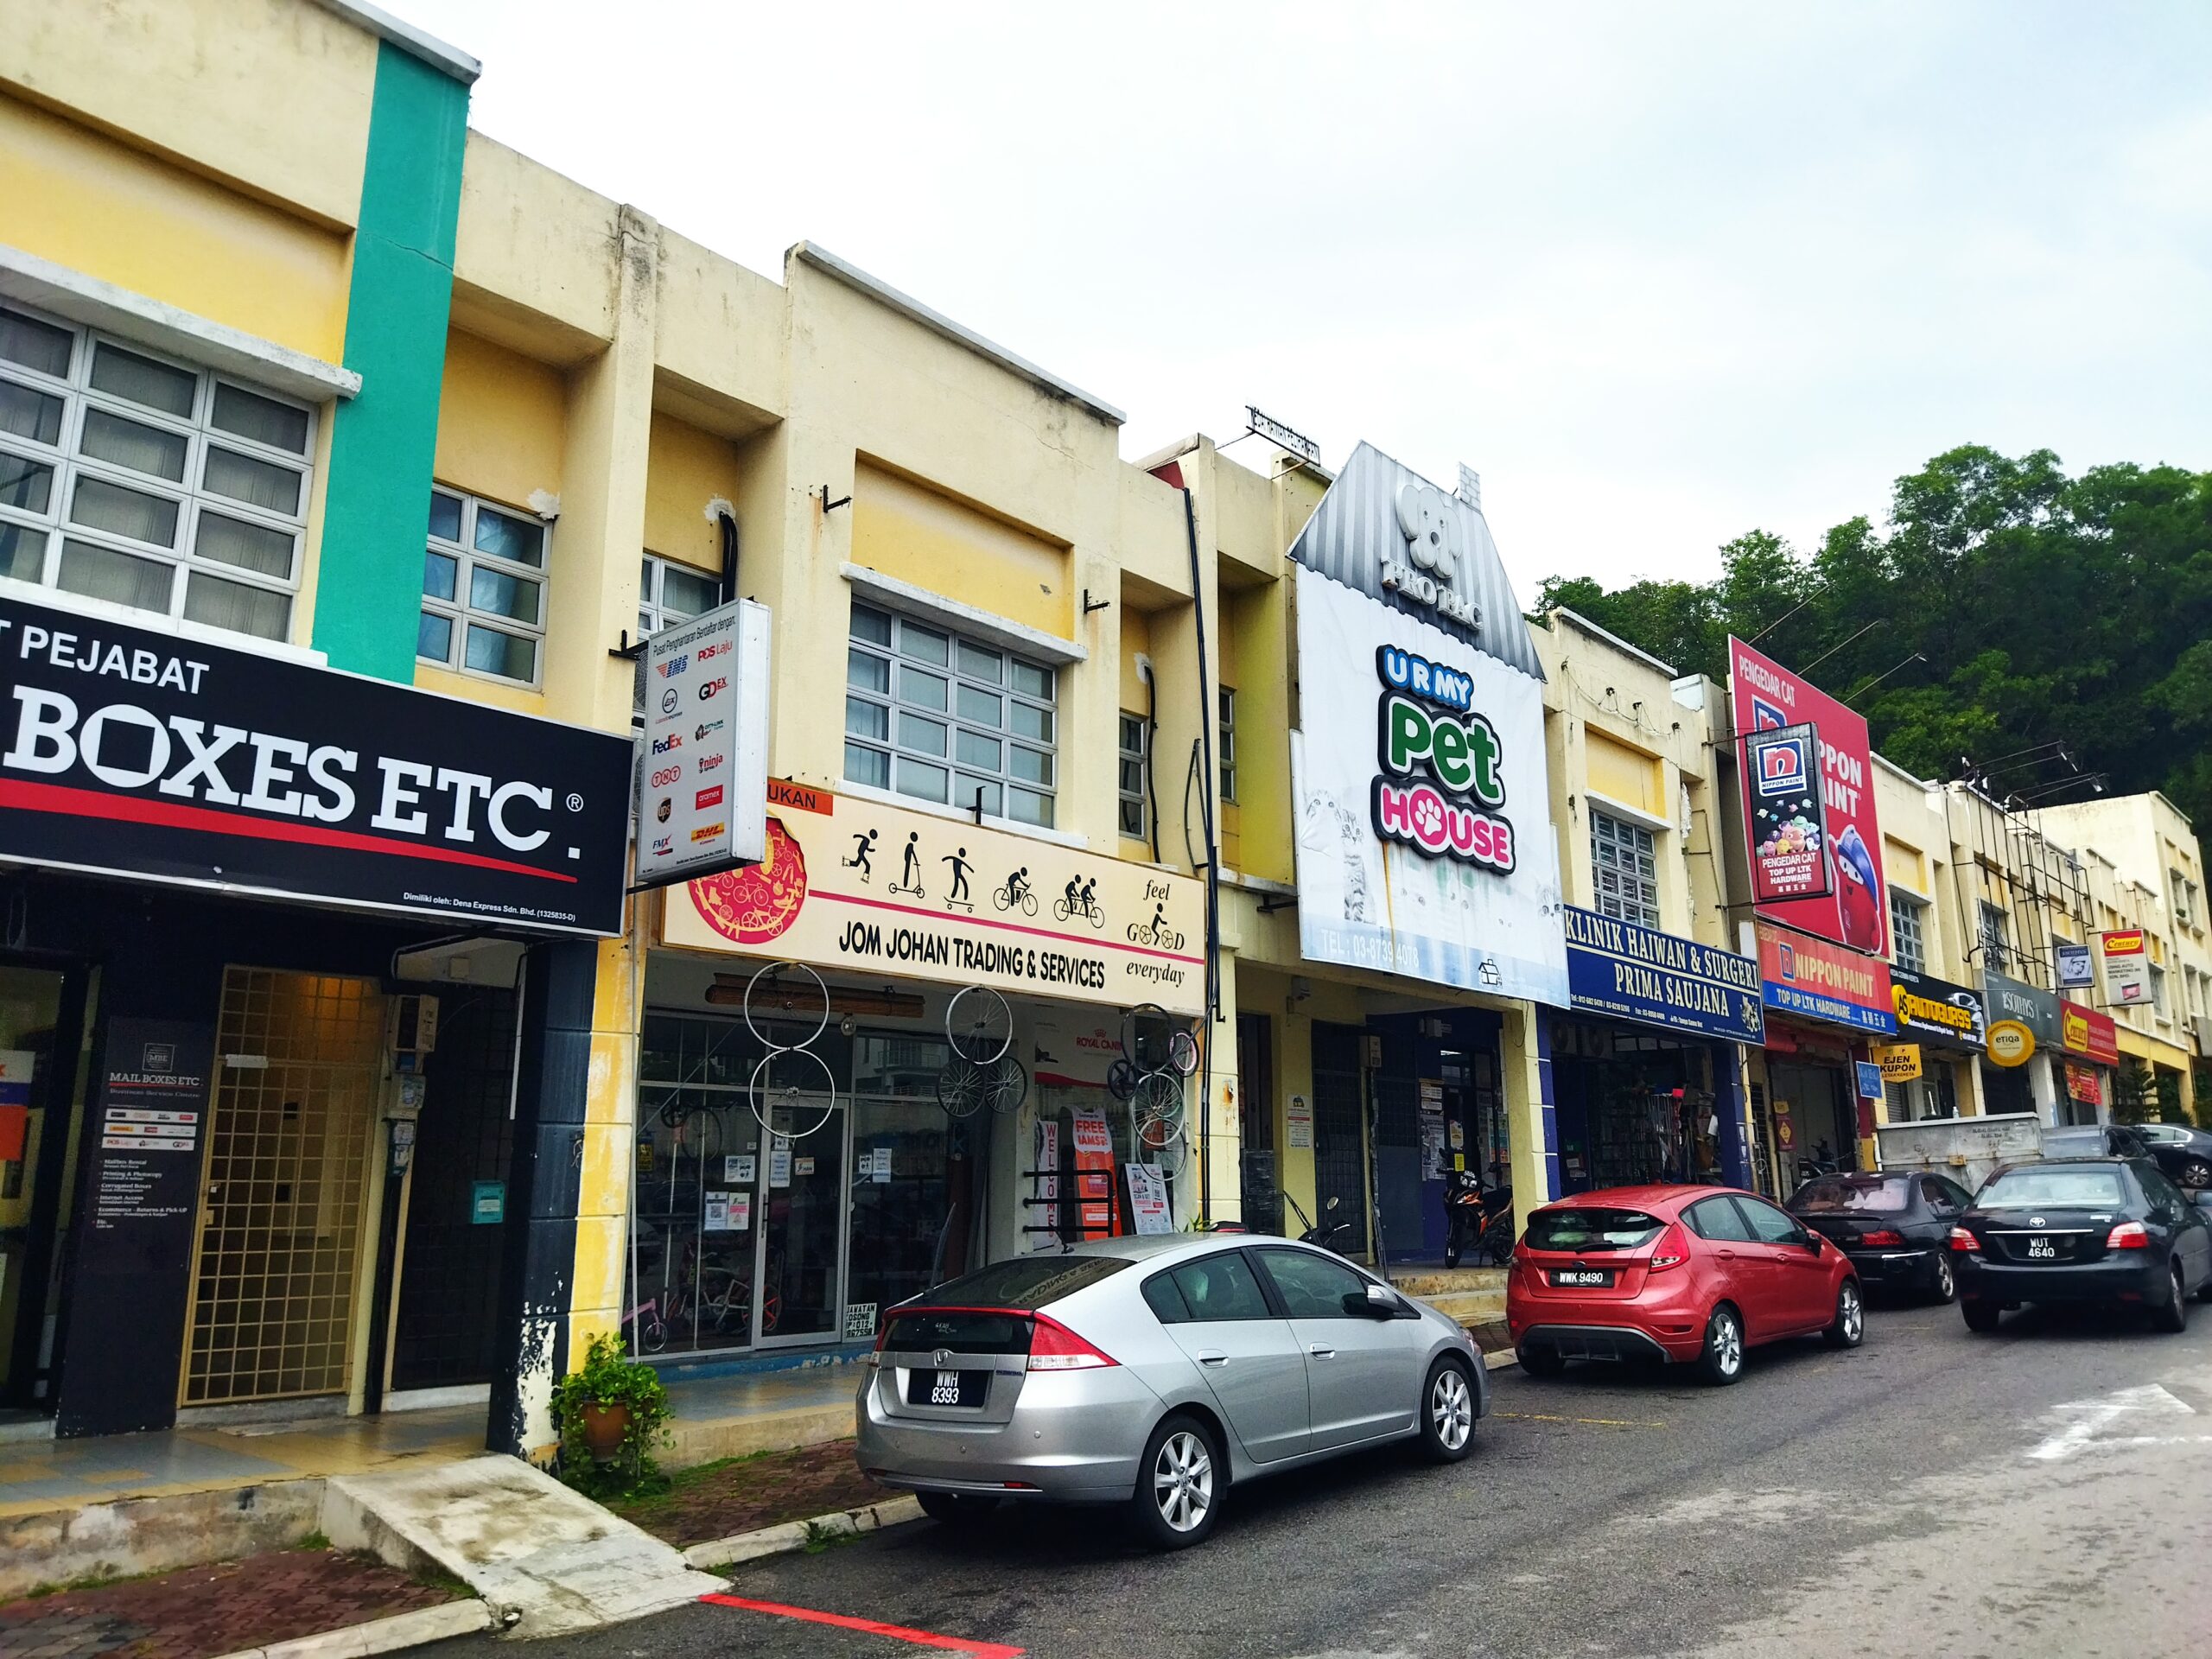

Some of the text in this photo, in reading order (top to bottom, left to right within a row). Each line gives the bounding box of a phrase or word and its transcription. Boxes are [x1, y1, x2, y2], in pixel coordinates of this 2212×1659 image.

[1380, 557, 1484, 630] PRO PAC
[653, 642, 667, 658] Pusat
[698, 639, 733, 662] POS Laju
[20, 625, 209, 694] PEJABAT
[1738, 653, 1796, 708] PENGEDAR CAT
[652, 734, 683, 755] FedEx
[3, 685, 358, 822] BOXES
[704, 753, 723, 768] ninja
[653, 767, 680, 785] TNT
[1762, 776, 1803, 789] NIPPON PAINT
[698, 790, 720, 803] aramex
[767, 784, 816, 810] UKAN
[658, 804, 671, 820] ups
[695, 825, 719, 839] DHL
[1382, 787, 1510, 864] HOUSE
[652, 834, 672, 849] FMX
[1762, 853, 1816, 868] PENGEDAR CAT
[1797, 865, 1811, 874] LTK
[1770, 873, 1812, 885] HARDWARE
[1142, 879, 1170, 901] feel
[433, 897, 452, 906] oleh:
[453, 899, 472, 908] Dena
[473, 901, 502, 912] Express
[503, 905, 519, 914] Sdn.
[520, 907, 536, 917] Bhd.
[839, 920, 1105, 989] JOM JOHAN TRADING & SERVICES
[1353, 938, 1394, 963] 03-8739
[1396, 944, 1420, 968] 4078
[1564, 910, 1758, 990] KLINIK HAIWAN & SURGERI
[1126, 961, 1185, 988] everyday
[1796, 952, 1873, 998] NIPPON PAINT
[1614, 962, 1662, 1002] PRIMA
[1666, 976, 1730, 1018] SAUJANA
[1777, 988, 1851, 1020] TOP UP LTK HARDWARE
[1076, 1037, 1100, 1049] ROYAL
[1880, 1064, 1916, 1073] KUPON
[1884, 1055, 1910, 1065] EJEN
[110, 1072, 141, 1083] MAIL
[143, 1074, 176, 1085] BOXES
[1076, 1120, 1106, 1134] FREE
[2030, 1237, 2049, 1248] WUT
[2028, 1247, 2055, 1257] 4640
[1559, 1271, 1604, 1284] WWK 9490
[847, 1305, 875, 1313] JAWATAN
[937, 1370, 958, 1387] WWH
[931, 1387, 959, 1404] 8393
